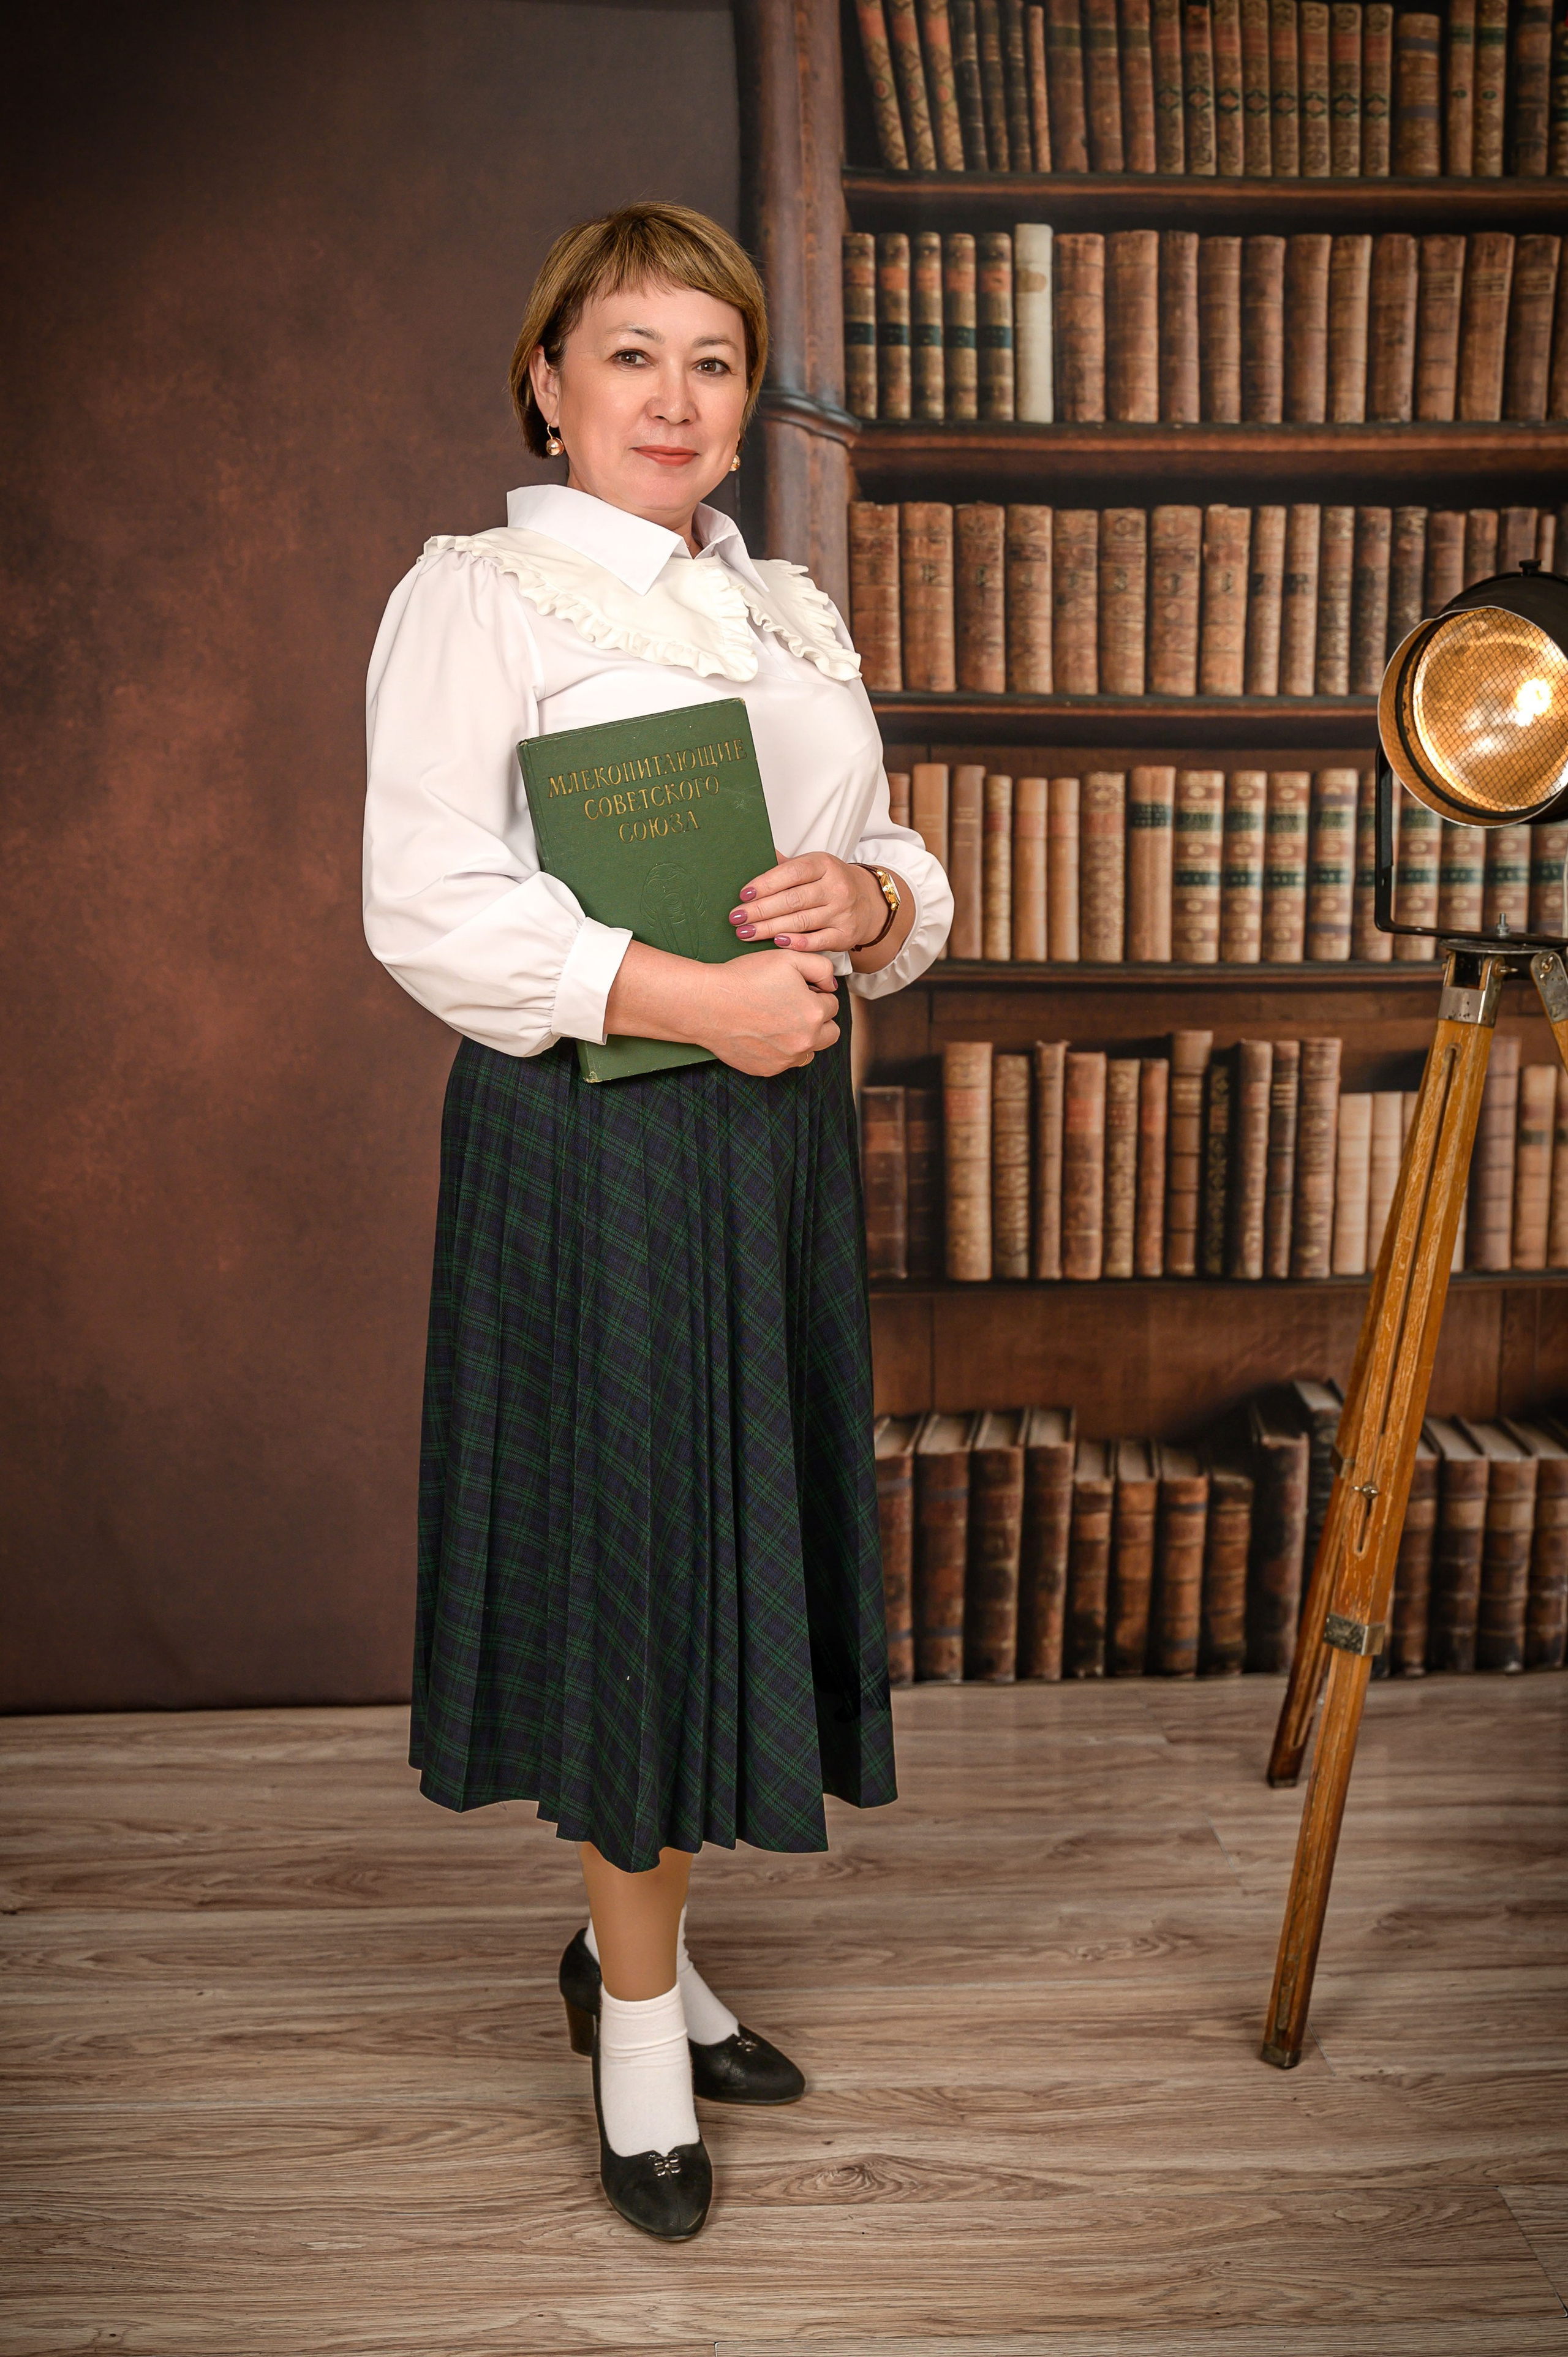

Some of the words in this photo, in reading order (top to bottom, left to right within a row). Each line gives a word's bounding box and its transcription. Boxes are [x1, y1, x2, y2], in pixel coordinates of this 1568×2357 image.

[548, 738, 747, 798] МЛЕКОПИТАЮЩИЕ
[584, 775, 720, 820] СОВЕТСКОГО
[619, 810, 701, 843] СОЮЗА
